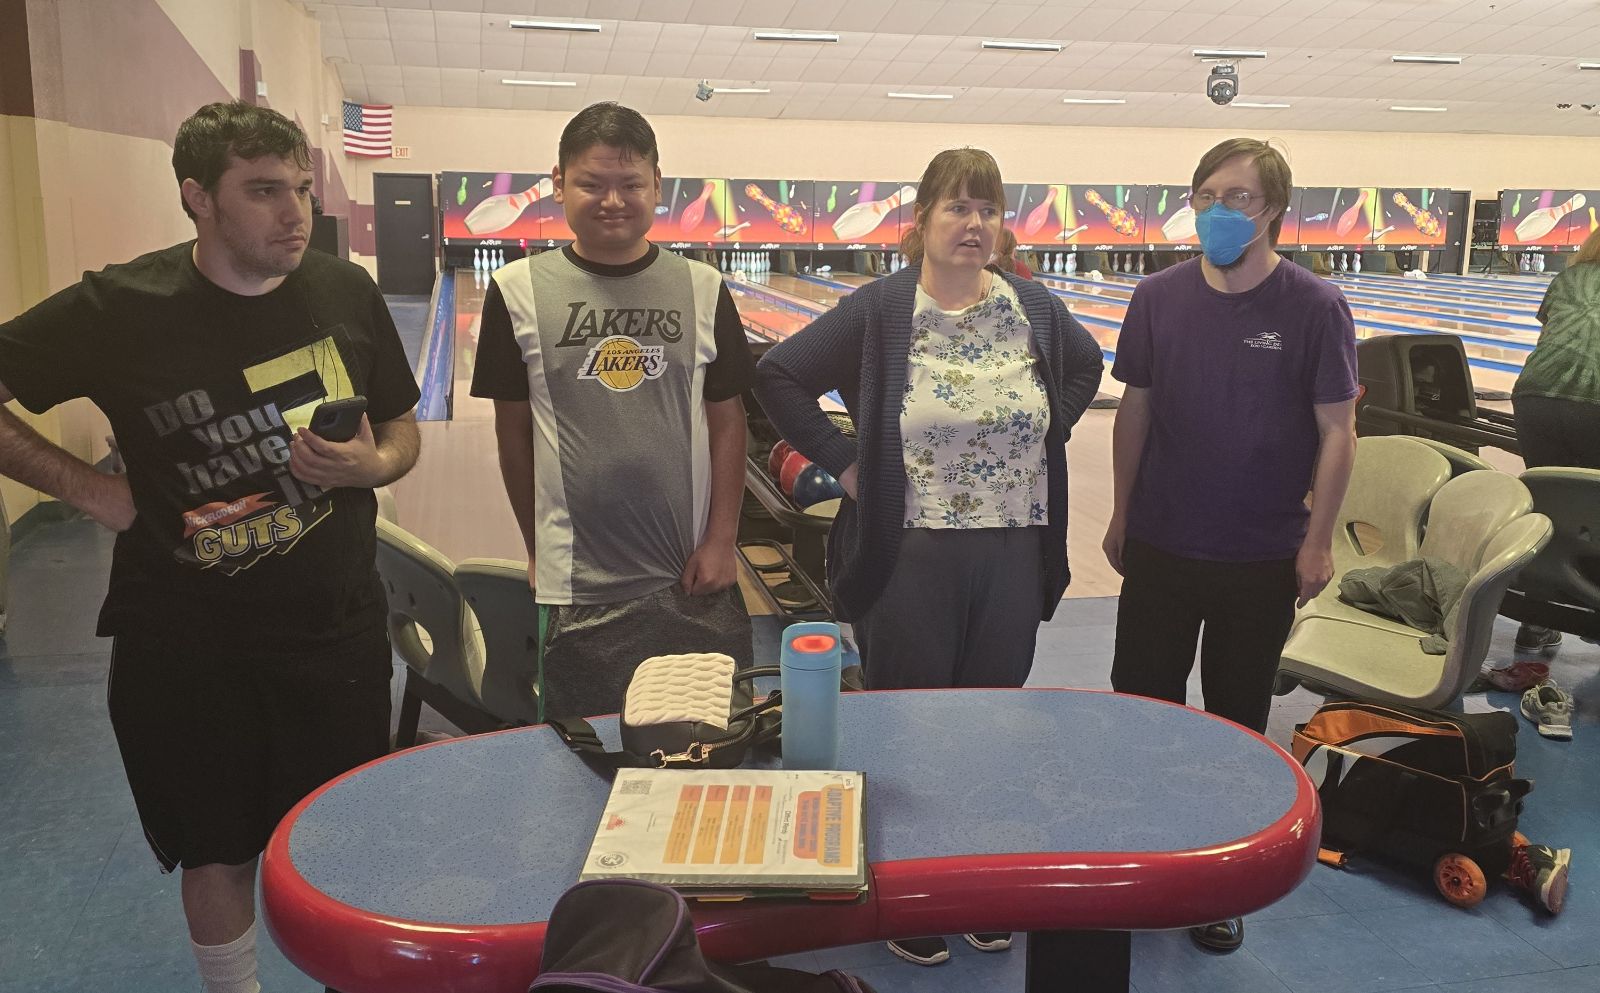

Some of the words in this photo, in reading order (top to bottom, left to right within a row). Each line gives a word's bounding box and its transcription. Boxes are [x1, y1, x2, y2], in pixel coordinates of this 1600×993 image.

[395, 147, 408, 157] EXIT
[443, 237, 449, 246] 1
[547, 239, 555, 248] 2
[733, 242, 741, 250] 4
[817, 243, 824, 251] 5
[1071, 244, 1078, 252] 8
[1148, 243, 1155, 252] 9
[1300, 244, 1308, 252] 11
[1377, 244, 1386, 252] 12
[1500, 244, 1509, 252] 13
[554, 301, 684, 348] LAKERS
[623, 347, 661, 355] ANGELES
[581, 350, 665, 377] LAKERS
[176, 434, 291, 495] have
[183, 499, 247, 528] NICKELODEON
[193, 504, 303, 561] GUTS
